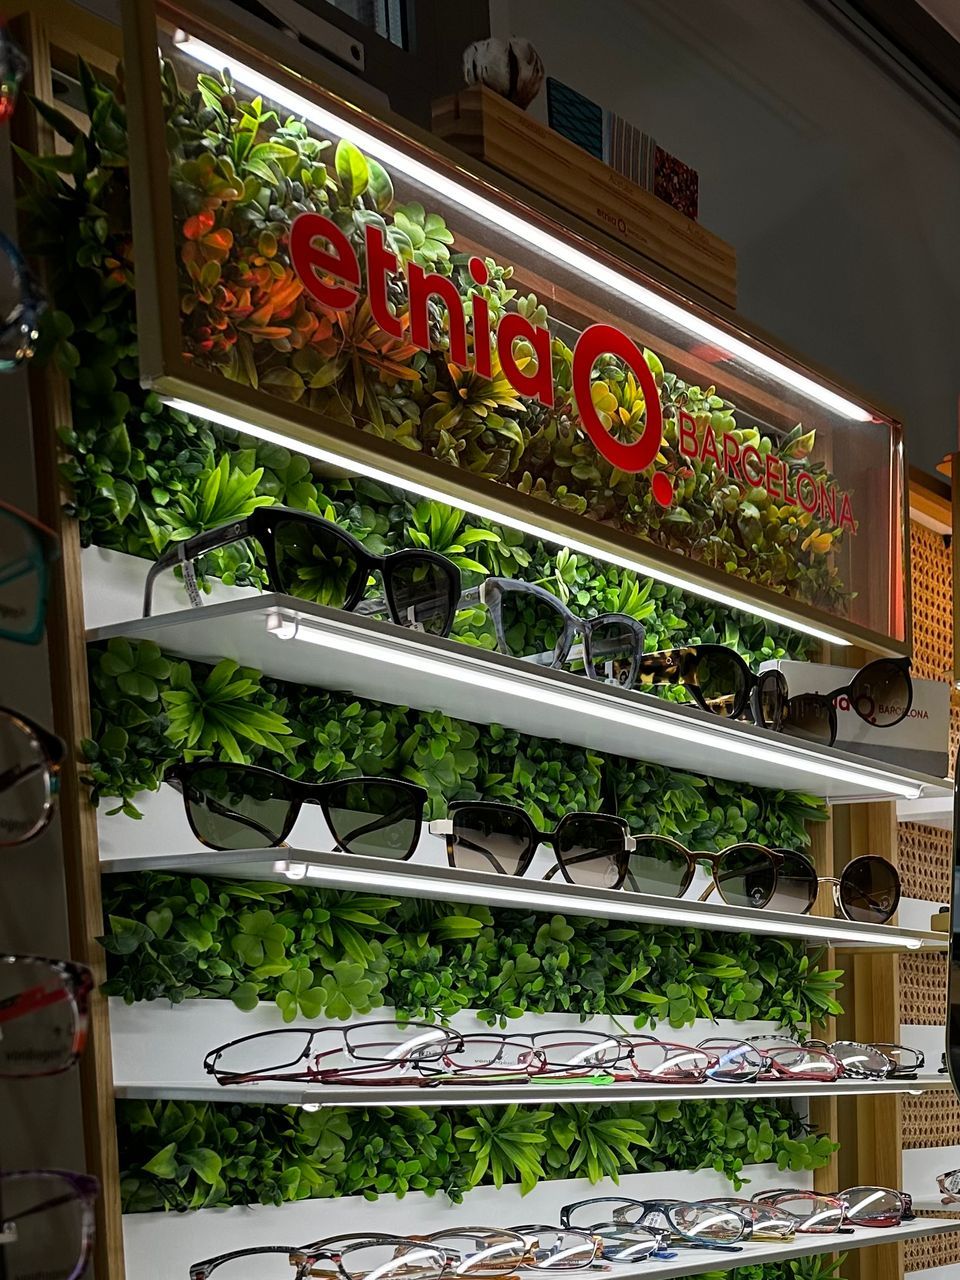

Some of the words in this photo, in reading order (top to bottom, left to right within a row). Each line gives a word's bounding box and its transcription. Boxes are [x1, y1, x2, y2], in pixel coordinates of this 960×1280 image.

[289, 211, 555, 408] etnia
[678, 410, 858, 535] BARCELONA
[878, 704, 929, 720] BARCLONA
